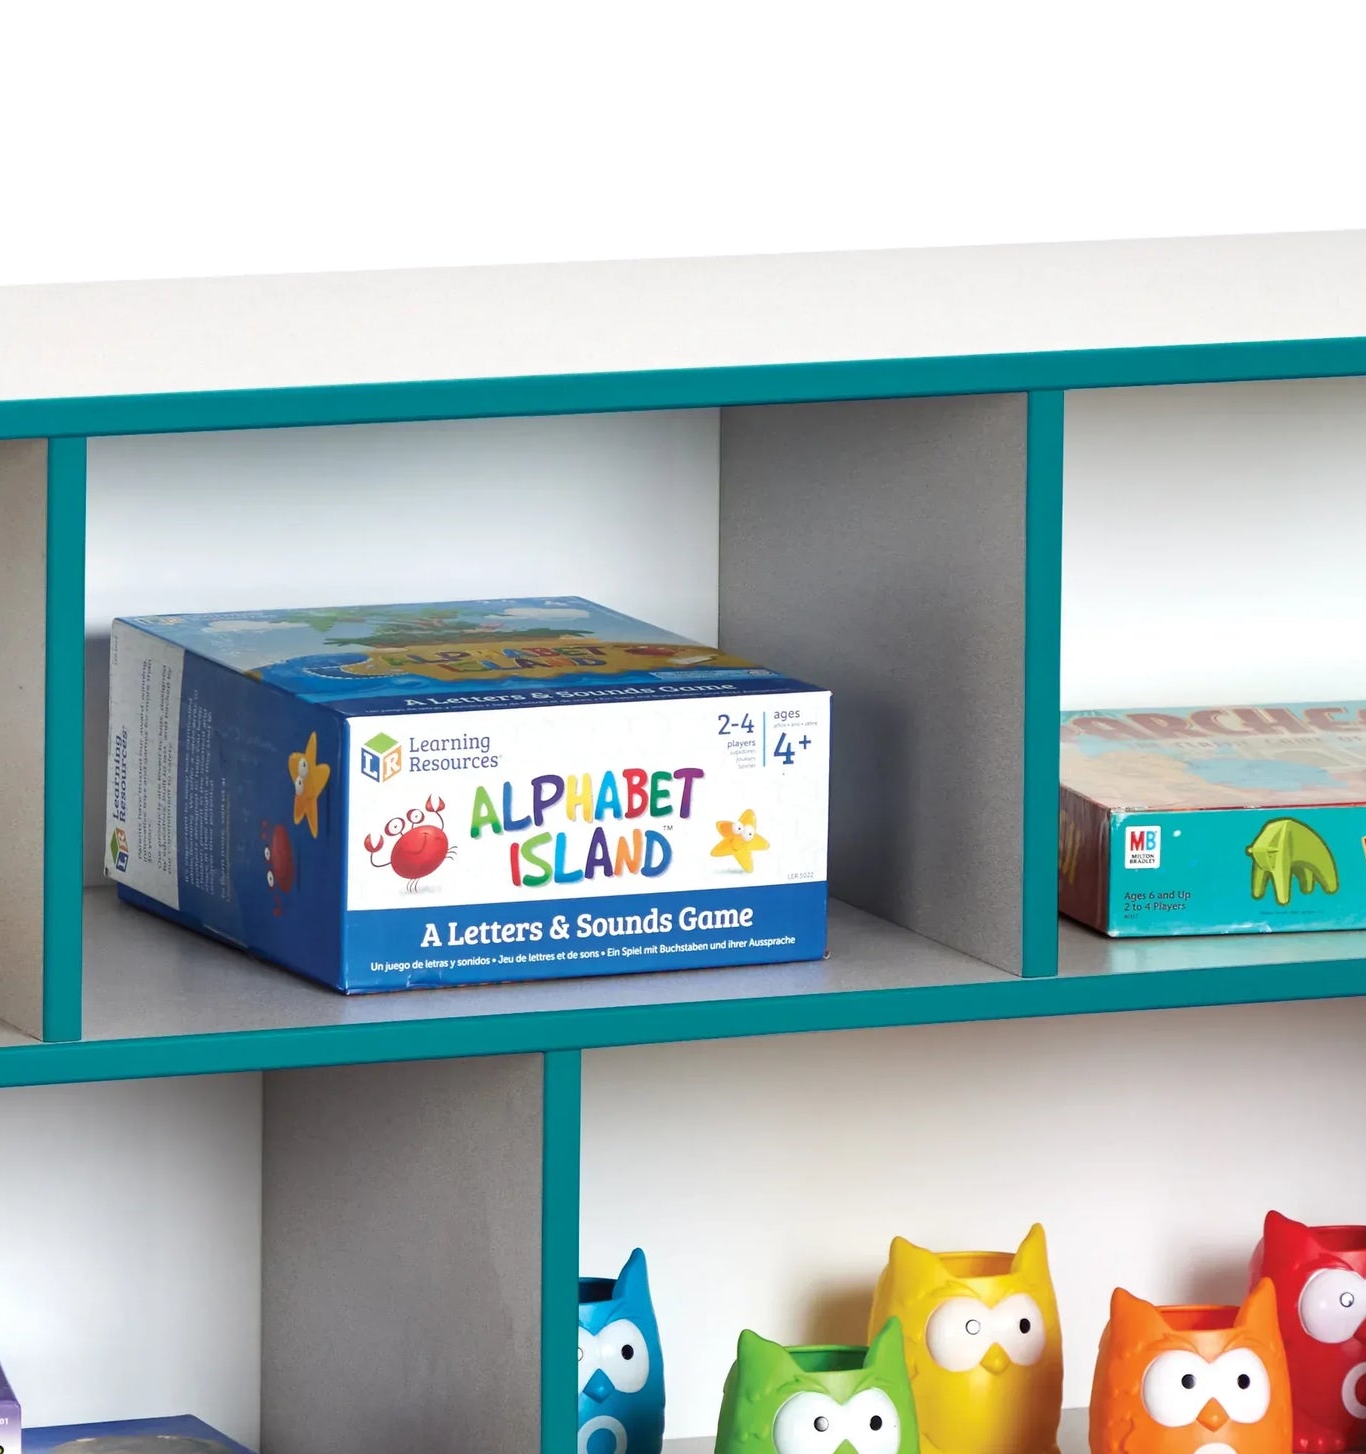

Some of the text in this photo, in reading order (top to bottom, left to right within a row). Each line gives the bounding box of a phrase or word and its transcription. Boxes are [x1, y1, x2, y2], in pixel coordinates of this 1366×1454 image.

[428, 695, 527, 705] Letters
[556, 687, 654, 698] Sounds
[661, 683, 738, 692] Game
[718, 713, 755, 735] 2-4
[774, 709, 800, 721] ages
[409, 733, 491, 753] Learning
[727, 740, 756, 749] players
[774, 732, 811, 765] 4+
[409, 754, 499, 773] Resources
[112, 736, 123, 820] Learning
[120, 729, 129, 823] Resources
[470, 767, 705, 839] ALPHABET
[1130, 831, 1156, 851] MB
[510, 826, 673, 887] ISLAND
[1124, 890, 1191, 902] Ages 6 and Up
[1124, 903, 1130, 911] 2
[1132, 903, 1142, 911] to
[1154, 901, 1186, 912] Players
[420, 906, 753, 948] A Letters & Sounds Game
[371, 936, 795, 973] Un juego de letras y sonidos Jeu de lettres et de sons Ein Spiel mit Buchstaben und ihrer Aussprache
